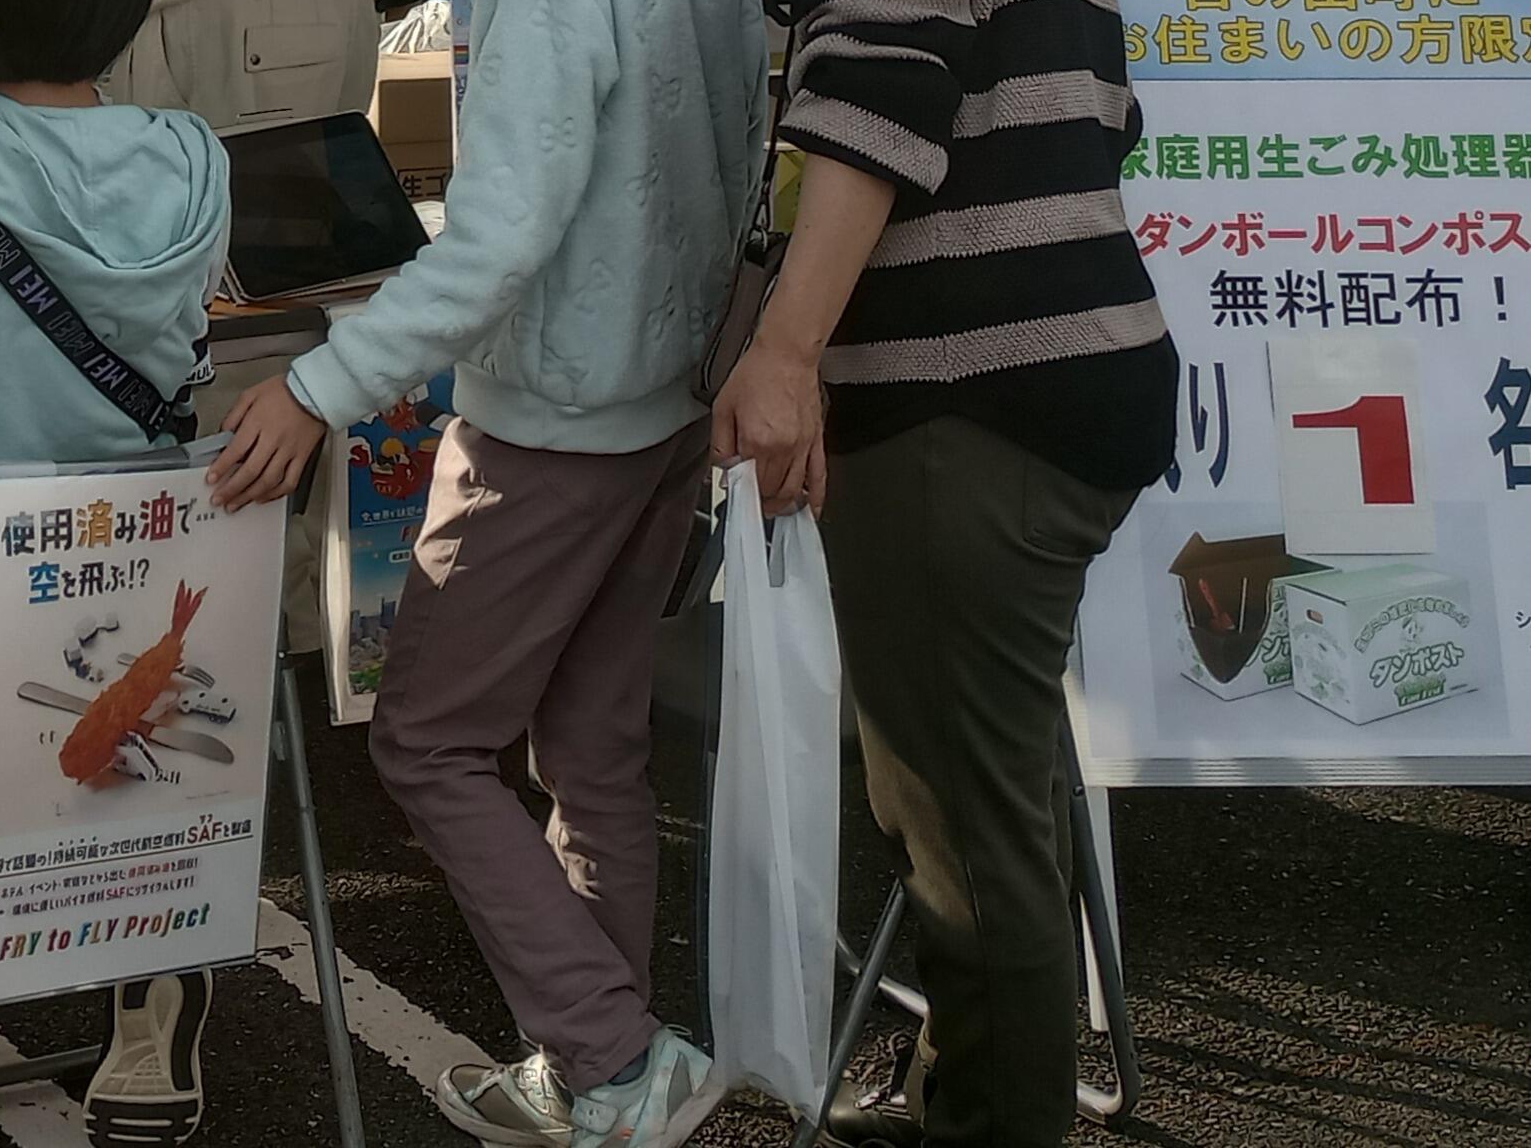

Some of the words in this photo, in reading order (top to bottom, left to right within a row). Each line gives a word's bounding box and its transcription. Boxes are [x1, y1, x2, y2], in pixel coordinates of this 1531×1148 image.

[1292, 396, 1415, 505] 1
[47, 928, 71, 952] to
[77, 919, 118, 947] FLY
[122, 903, 211, 939] Project
